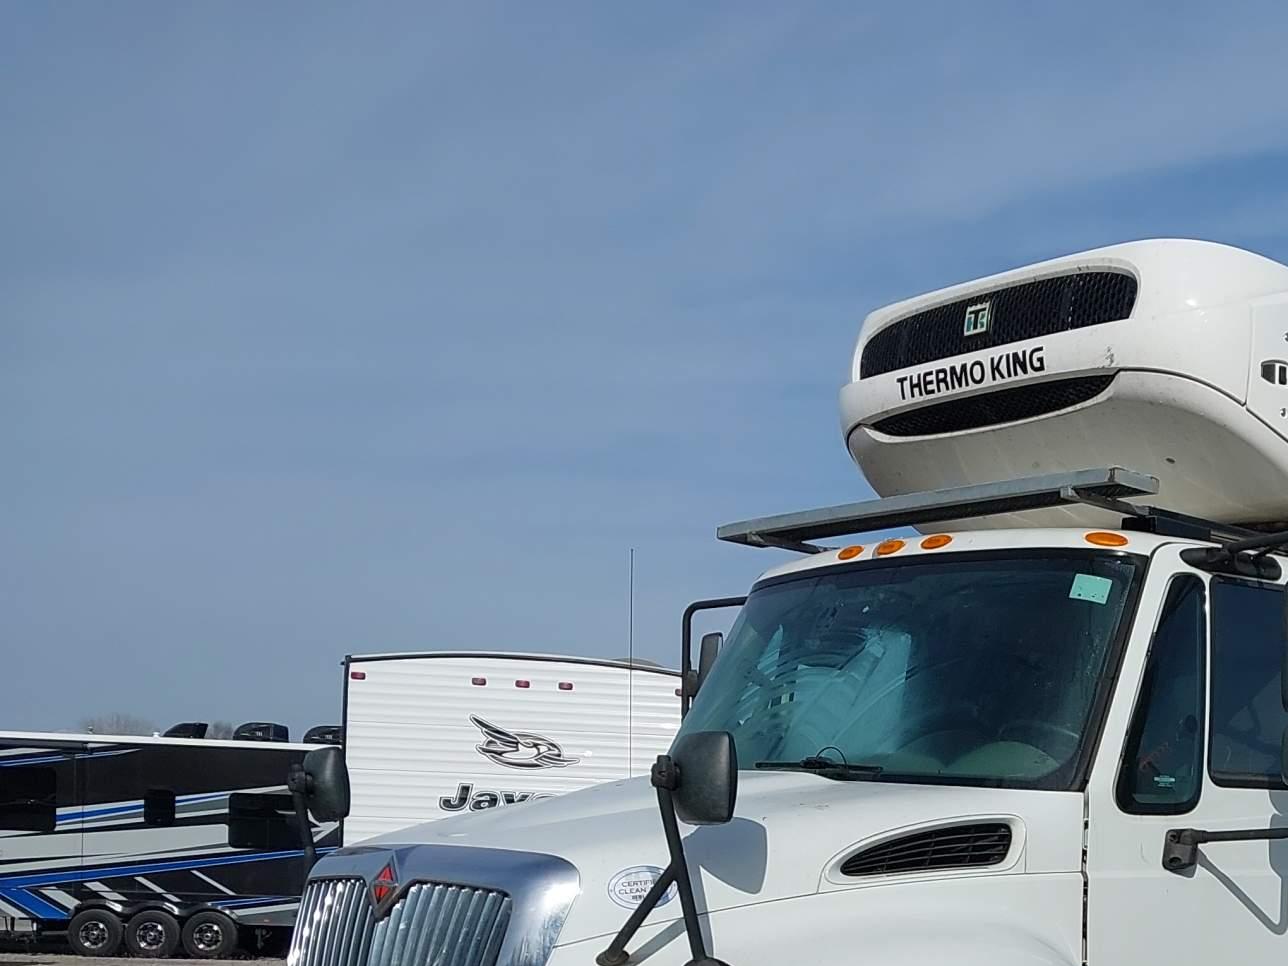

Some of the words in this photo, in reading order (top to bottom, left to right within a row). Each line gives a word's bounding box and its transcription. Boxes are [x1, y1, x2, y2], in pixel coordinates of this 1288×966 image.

[896, 359, 986, 401] THERMO
[990, 346, 1046, 382] KING
[618, 887, 647, 895] CLEAN
